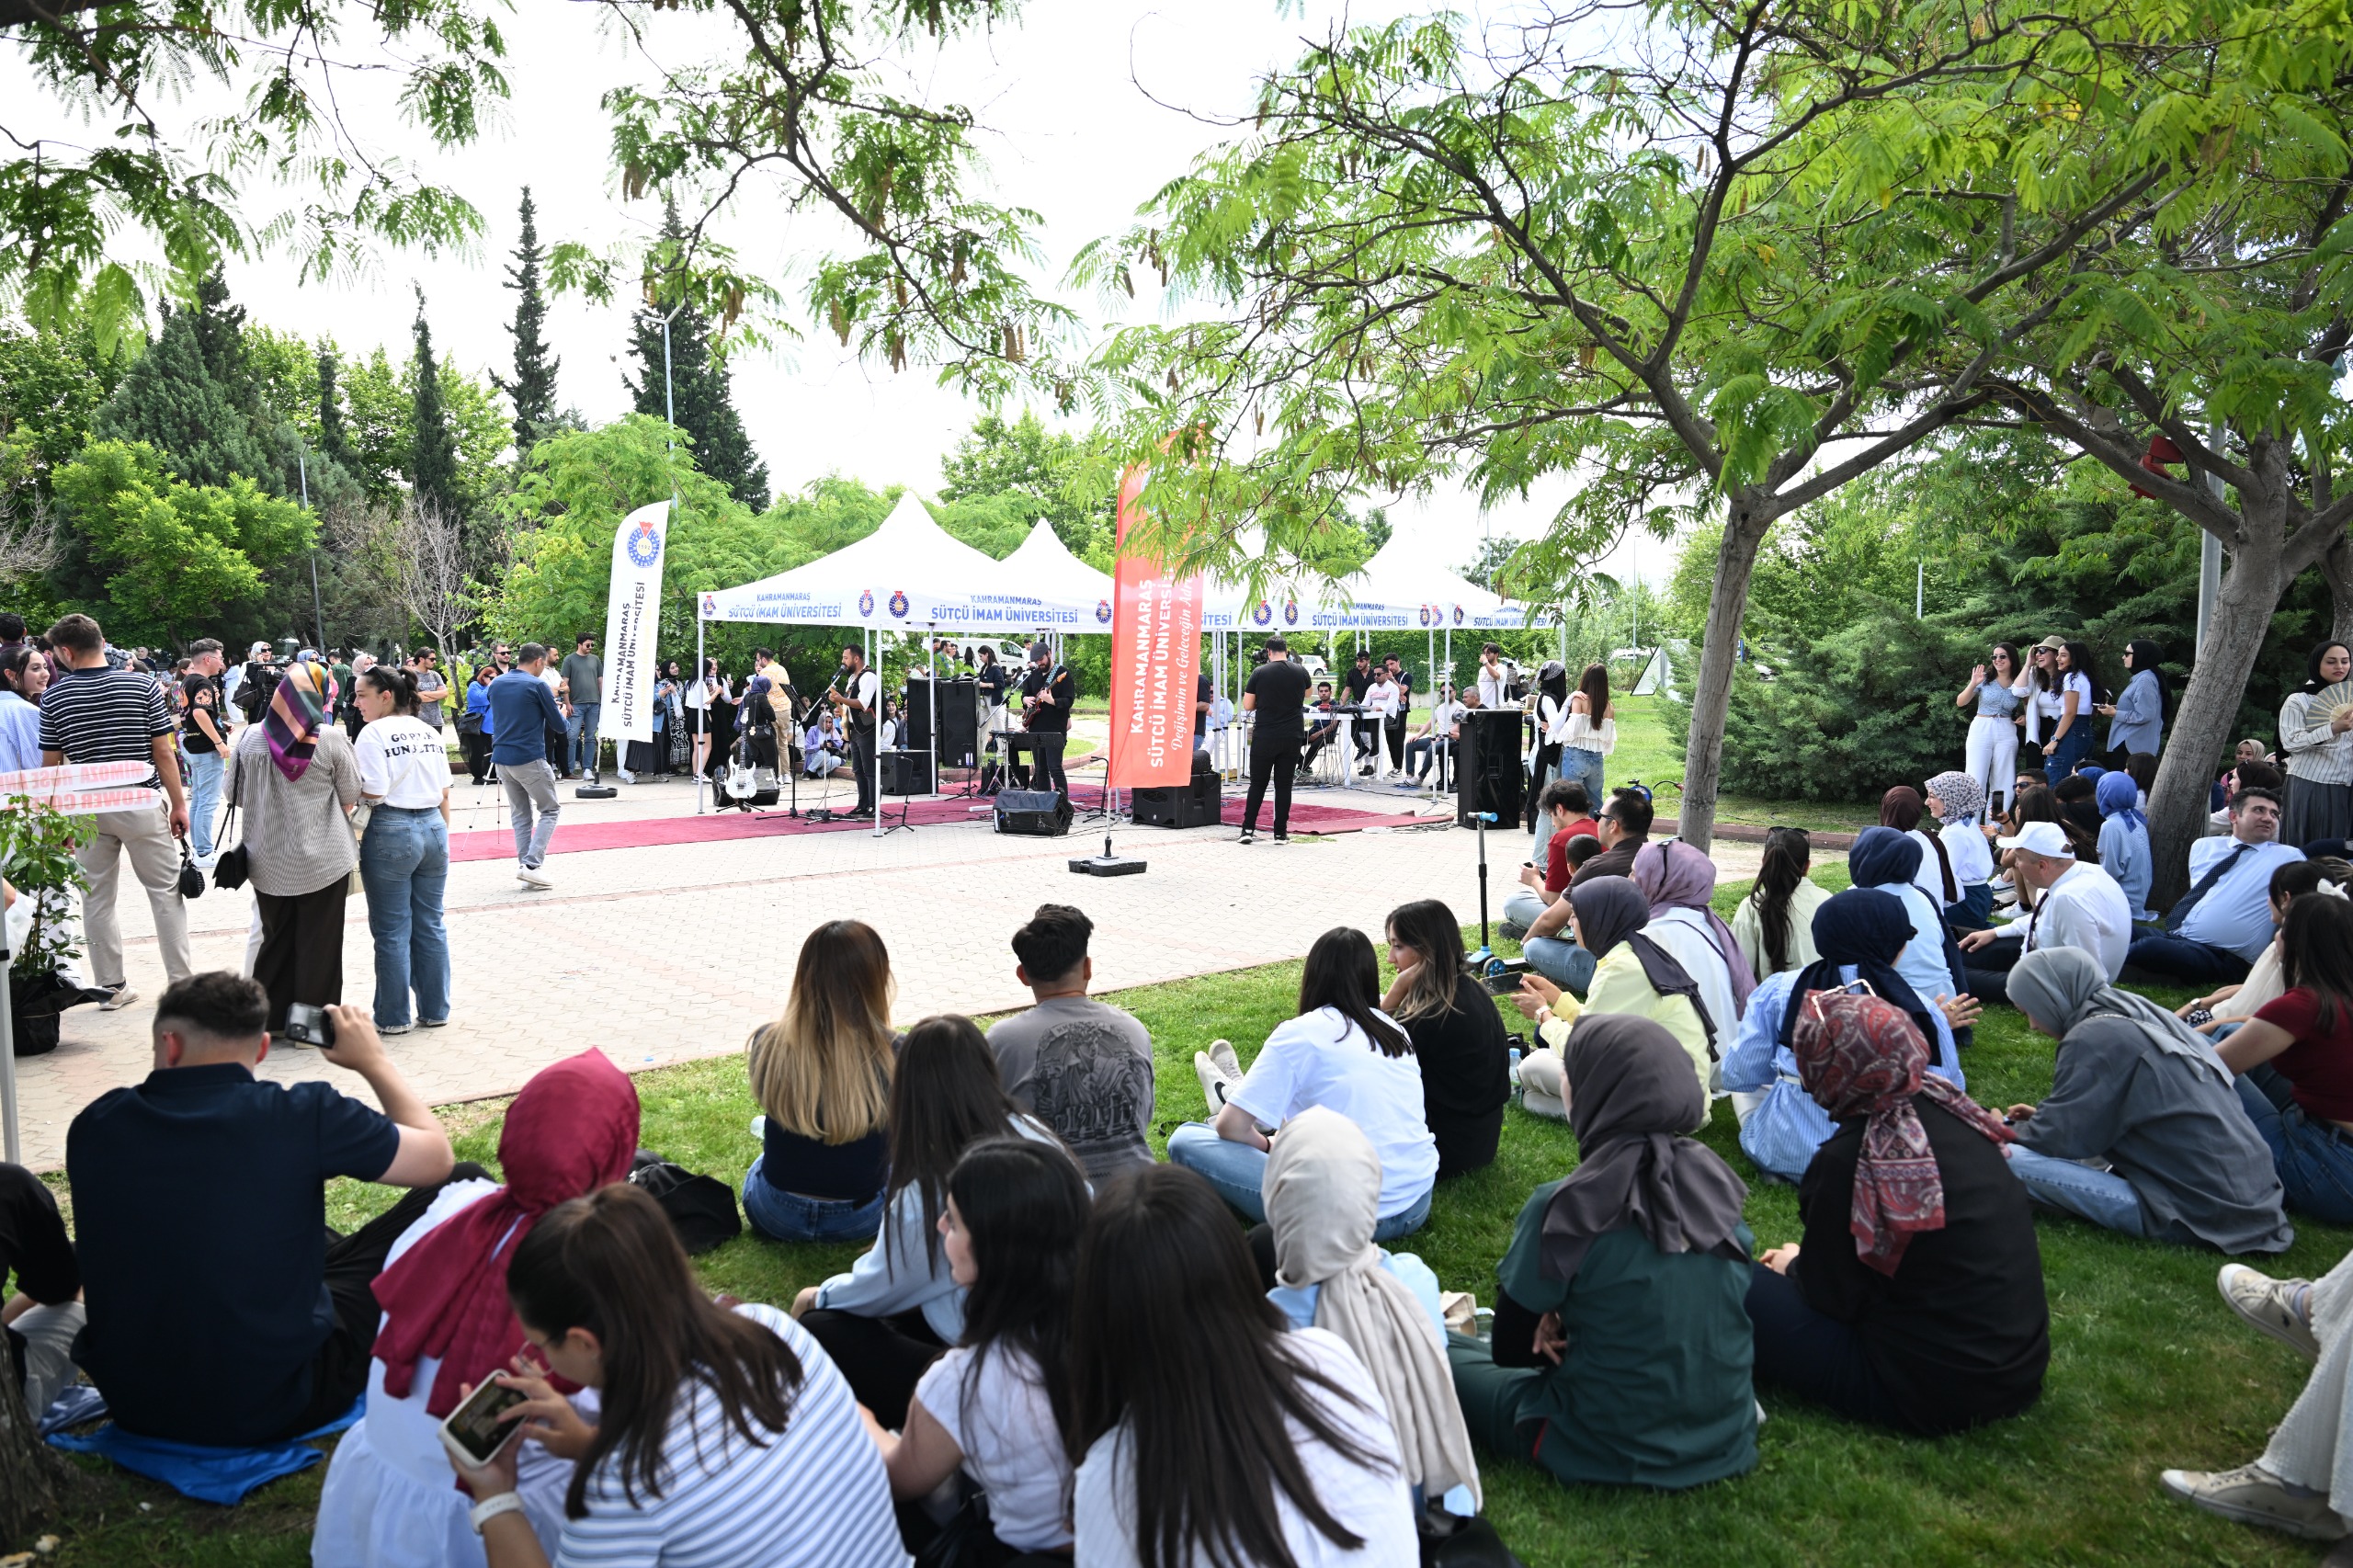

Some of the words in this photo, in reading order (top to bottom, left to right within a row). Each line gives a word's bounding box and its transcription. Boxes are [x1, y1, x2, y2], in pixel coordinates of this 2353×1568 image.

[756, 592, 811, 602] KAHRAMANMARAŞ
[970, 595, 1042, 608] KAHRAMANMARAŞ
[728, 604, 756, 620] SÜTÇÜ
[756, 604, 779, 618] İMAM
[780, 602, 842, 618] ÜNİVERSİTESİ
[931, 604, 970, 623] SÜTÇÜ
[972, 605, 1003, 620] İMAM
[1006, 607, 1078, 623] ÜNİVERSİTESİ
[1312, 612, 1337, 629] SÜTÇÜ
[1339, 612, 1359, 626] İMAM
[1360, 612, 1408, 627] ÜNİVERSİTESİ
[1176, 608, 1196, 669] Geleceğin
[1130, 579, 1155, 733] KAHRAMANMARAŞ
[623, 660, 636, 690] İMAM
[1179, 671, 1188, 686] ve
[1149, 665, 1169, 710] İMAM
[1171, 687, 1188, 751] Değişimin
[391, 733, 407, 743] GO
